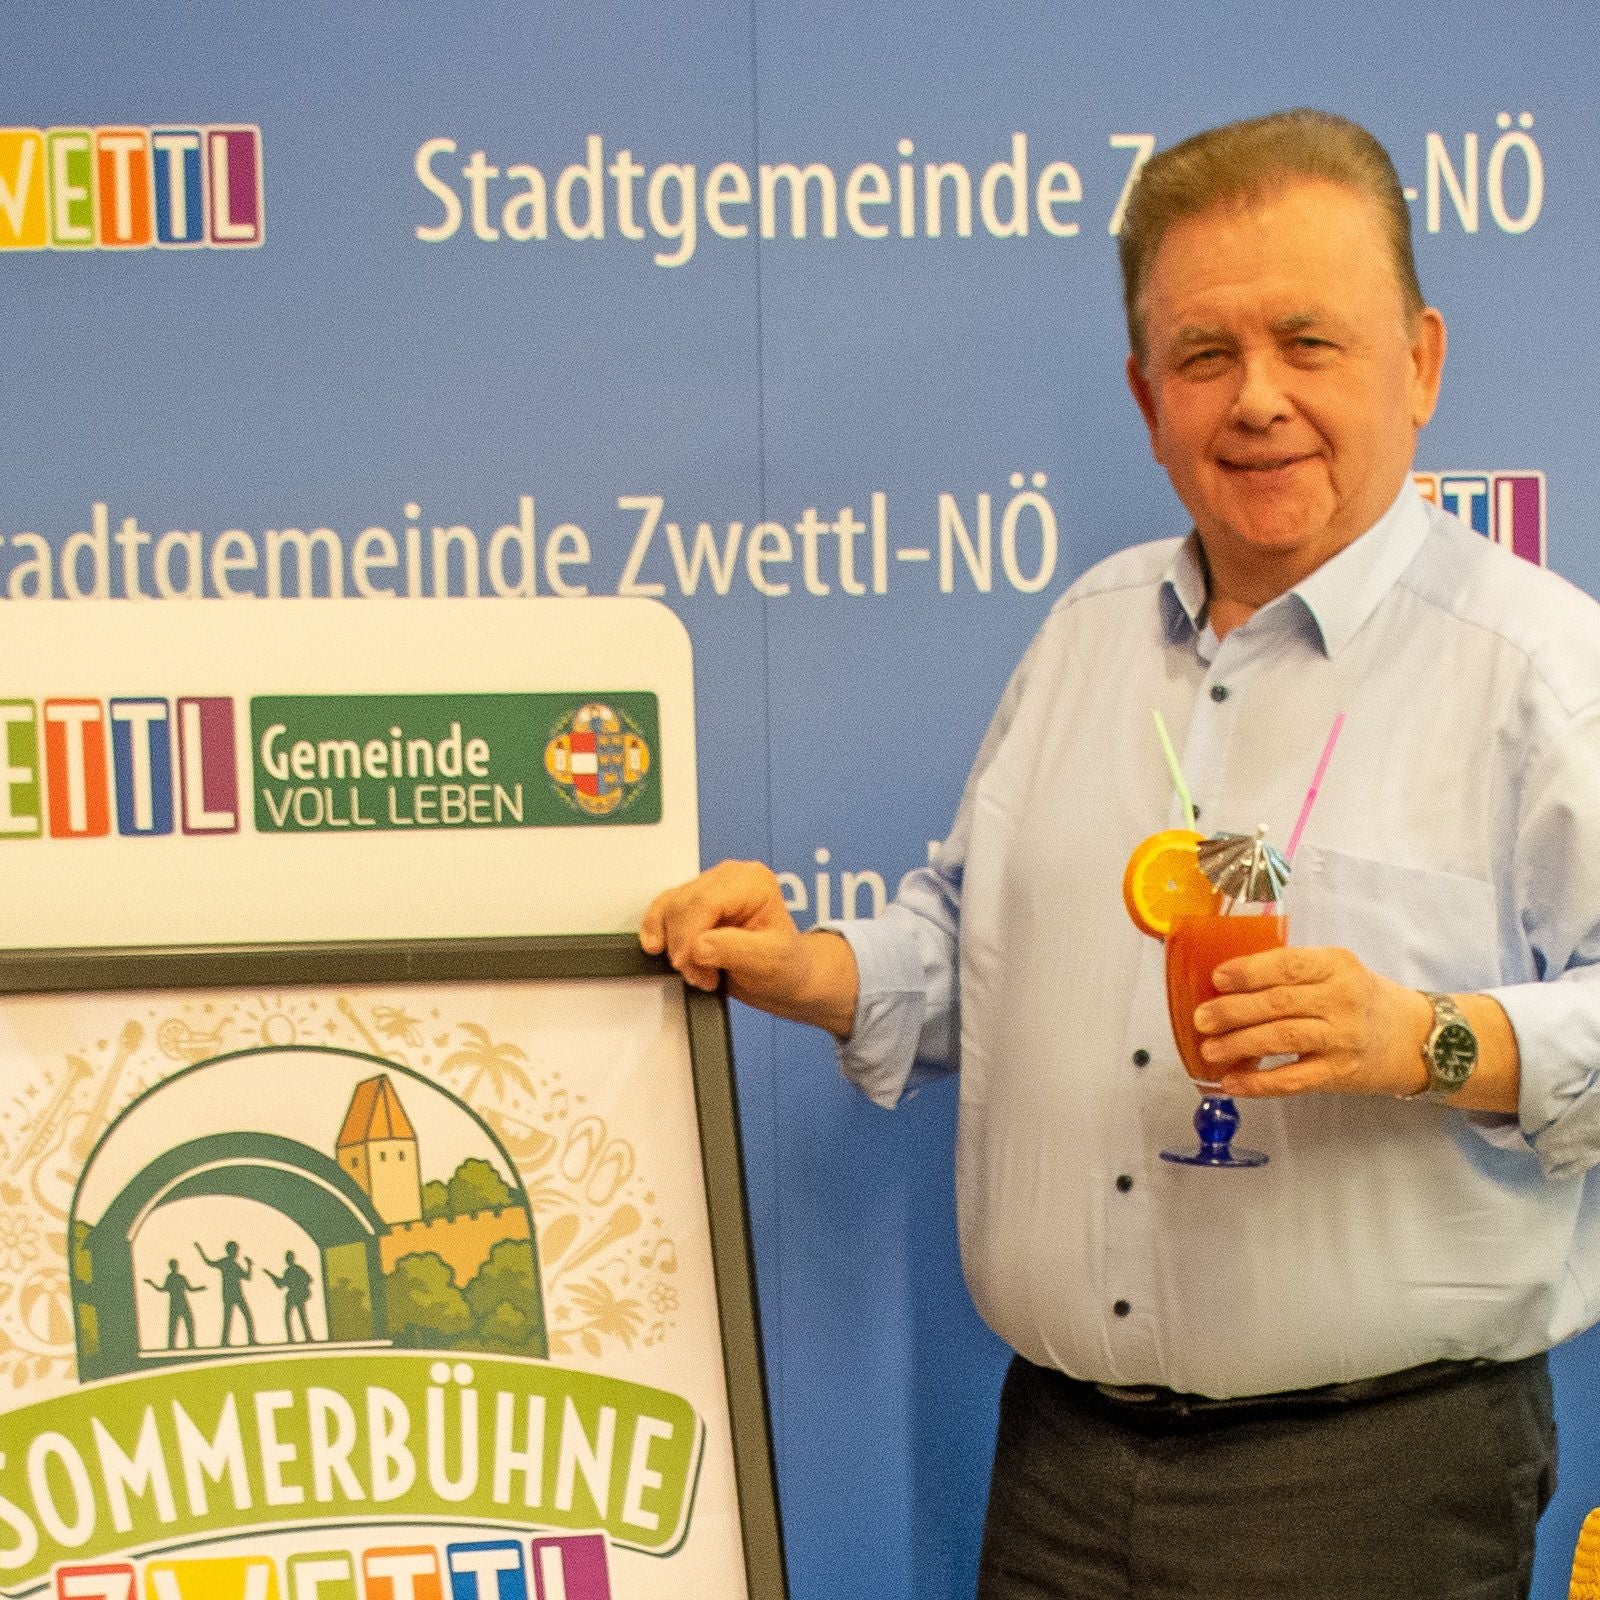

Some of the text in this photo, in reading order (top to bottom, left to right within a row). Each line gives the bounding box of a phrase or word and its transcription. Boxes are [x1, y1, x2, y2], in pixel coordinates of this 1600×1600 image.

[412, 131, 1083, 268] Stadtgemeinde
[615, 472, 1061, 598] Zwettl-NÖ
[260, 720, 491, 781] Gemeinde
[261, 782, 525, 828] VOLL LEBEN
